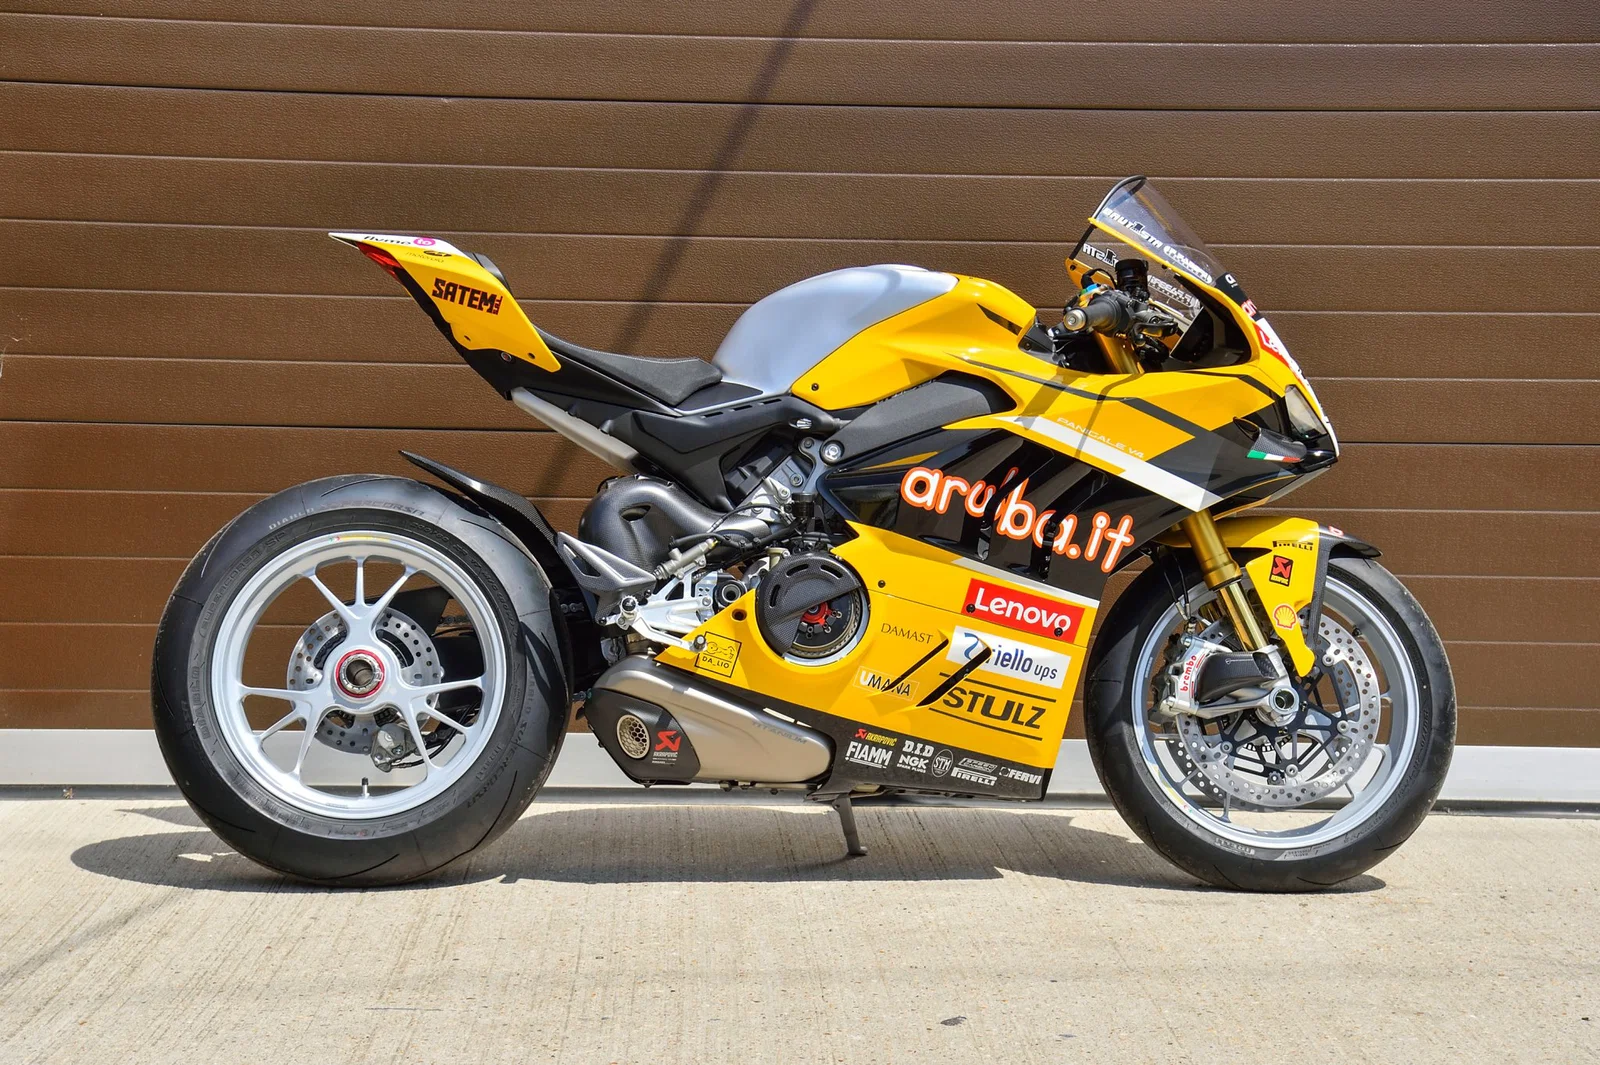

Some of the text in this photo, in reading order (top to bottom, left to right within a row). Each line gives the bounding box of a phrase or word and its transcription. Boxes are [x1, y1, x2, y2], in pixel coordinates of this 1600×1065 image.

[432, 277, 498, 313] SATEM
[1056, 417, 1144, 458] PANIGALE V4
[901, 466, 1135, 573] aruba.it
[973, 587, 1072, 632] Lenovo
[880, 622, 933, 644] DAMAST
[1033, 664, 1058, 682] ups
[1180, 655, 1197, 692] brembo
[942, 686, 1047, 729] STULZ
[846, 741, 892, 766] FIAMM
[899, 754, 929, 769] NGK
[933, 757, 951, 770] STM
[951, 767, 998, 786] PIRELLI
[1008, 769, 1042, 785] FERVI
